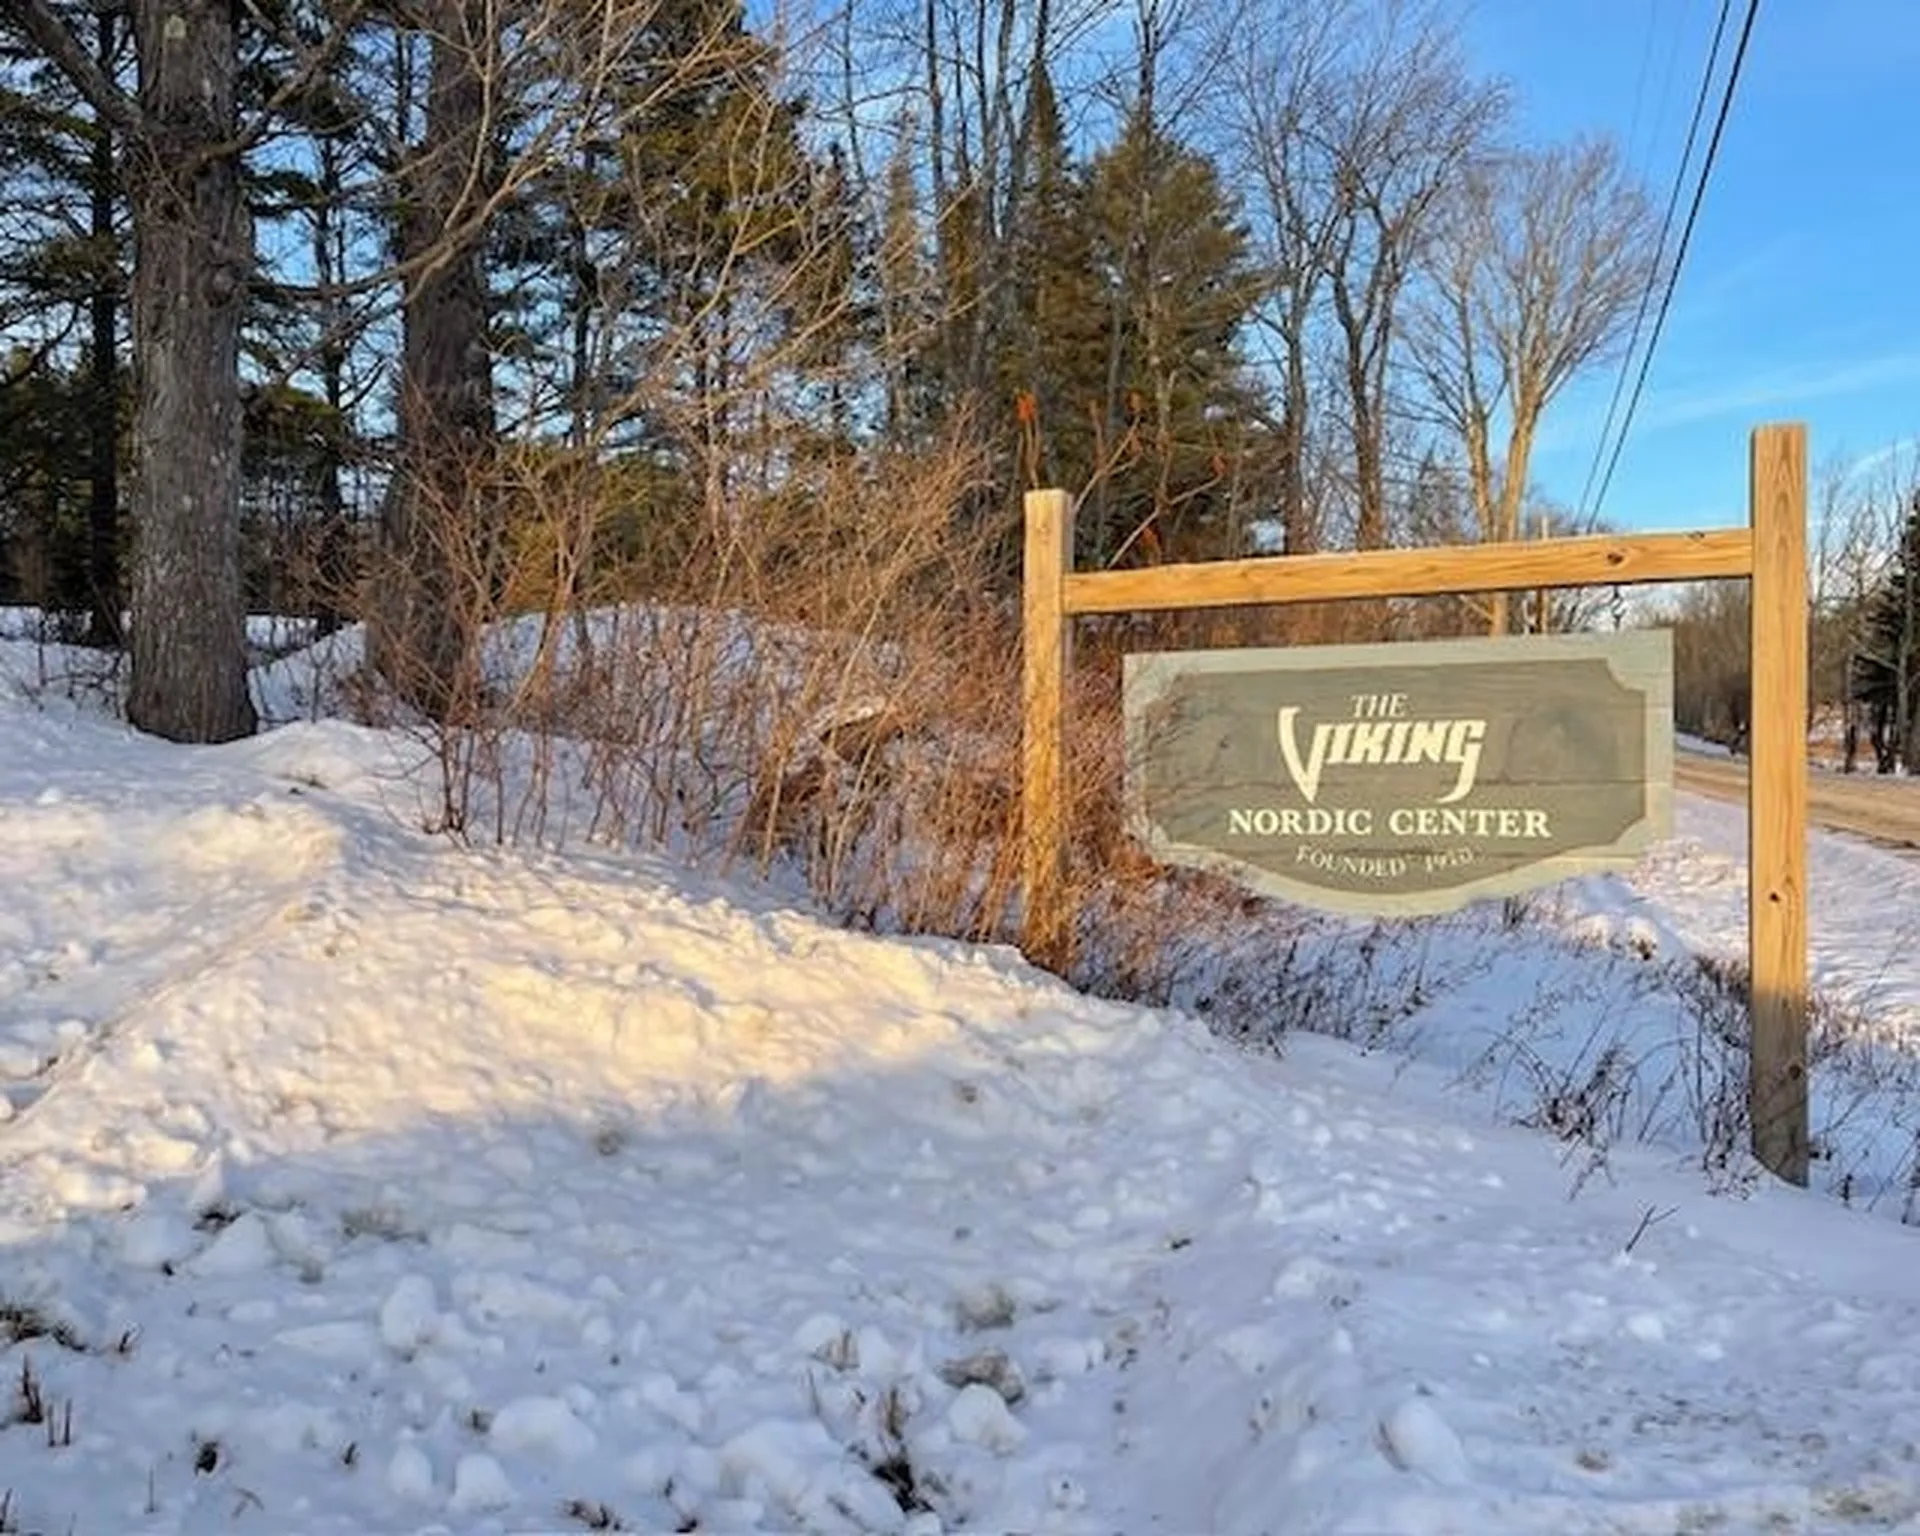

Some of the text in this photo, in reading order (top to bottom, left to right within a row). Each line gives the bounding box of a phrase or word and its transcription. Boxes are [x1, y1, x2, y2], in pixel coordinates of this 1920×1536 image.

[1352, 694, 1406, 717] THE
[1278, 707, 1486, 802] VIKING
[1228, 809, 1551, 838] NORDIC CENTER
[1297, 845, 1405, 877] FOUNDED
